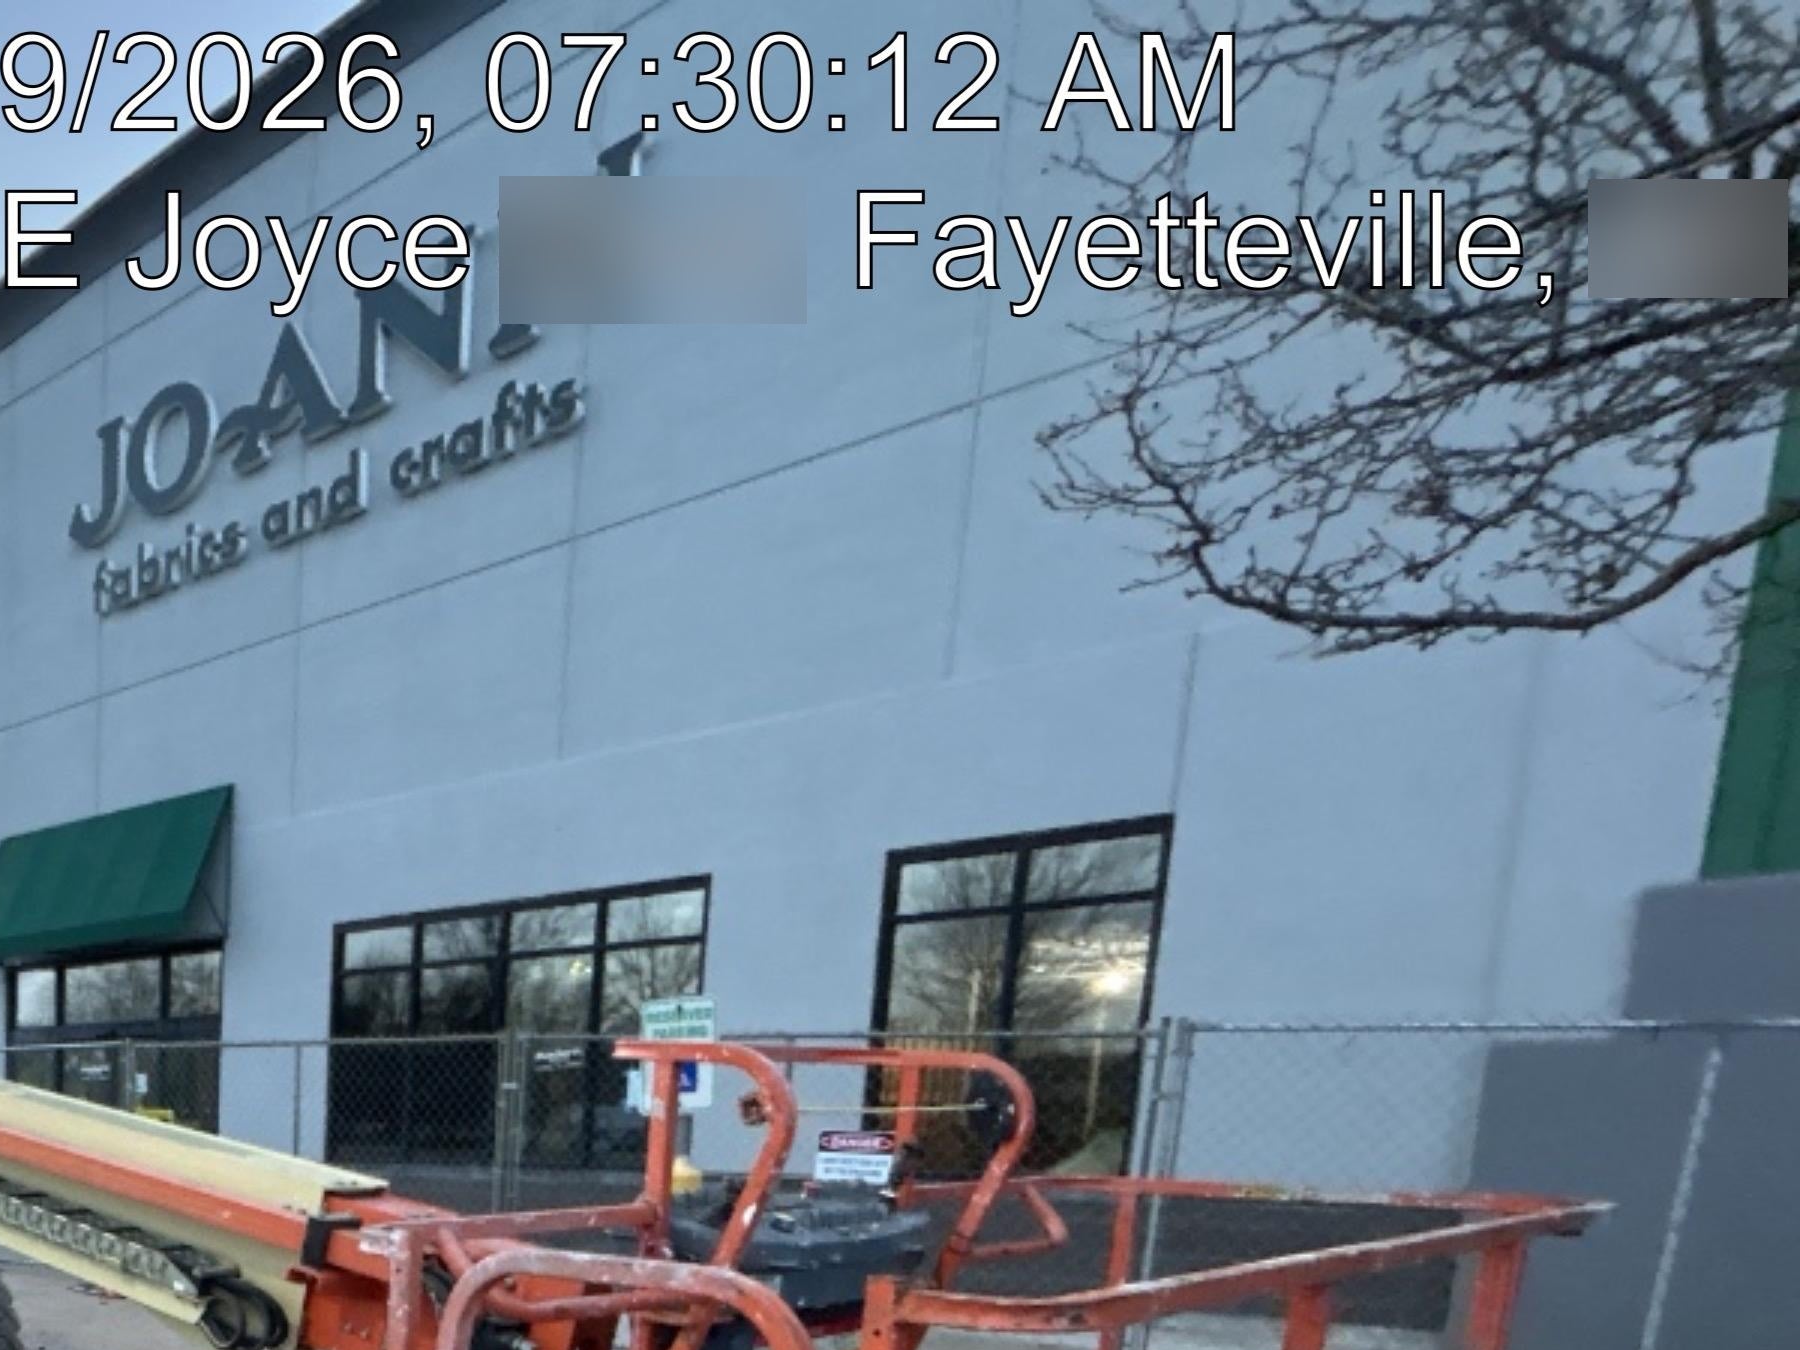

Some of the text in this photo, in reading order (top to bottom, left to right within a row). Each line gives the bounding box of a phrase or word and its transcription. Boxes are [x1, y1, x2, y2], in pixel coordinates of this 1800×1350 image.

[92, 376, 588, 617] fabrics and crafts
